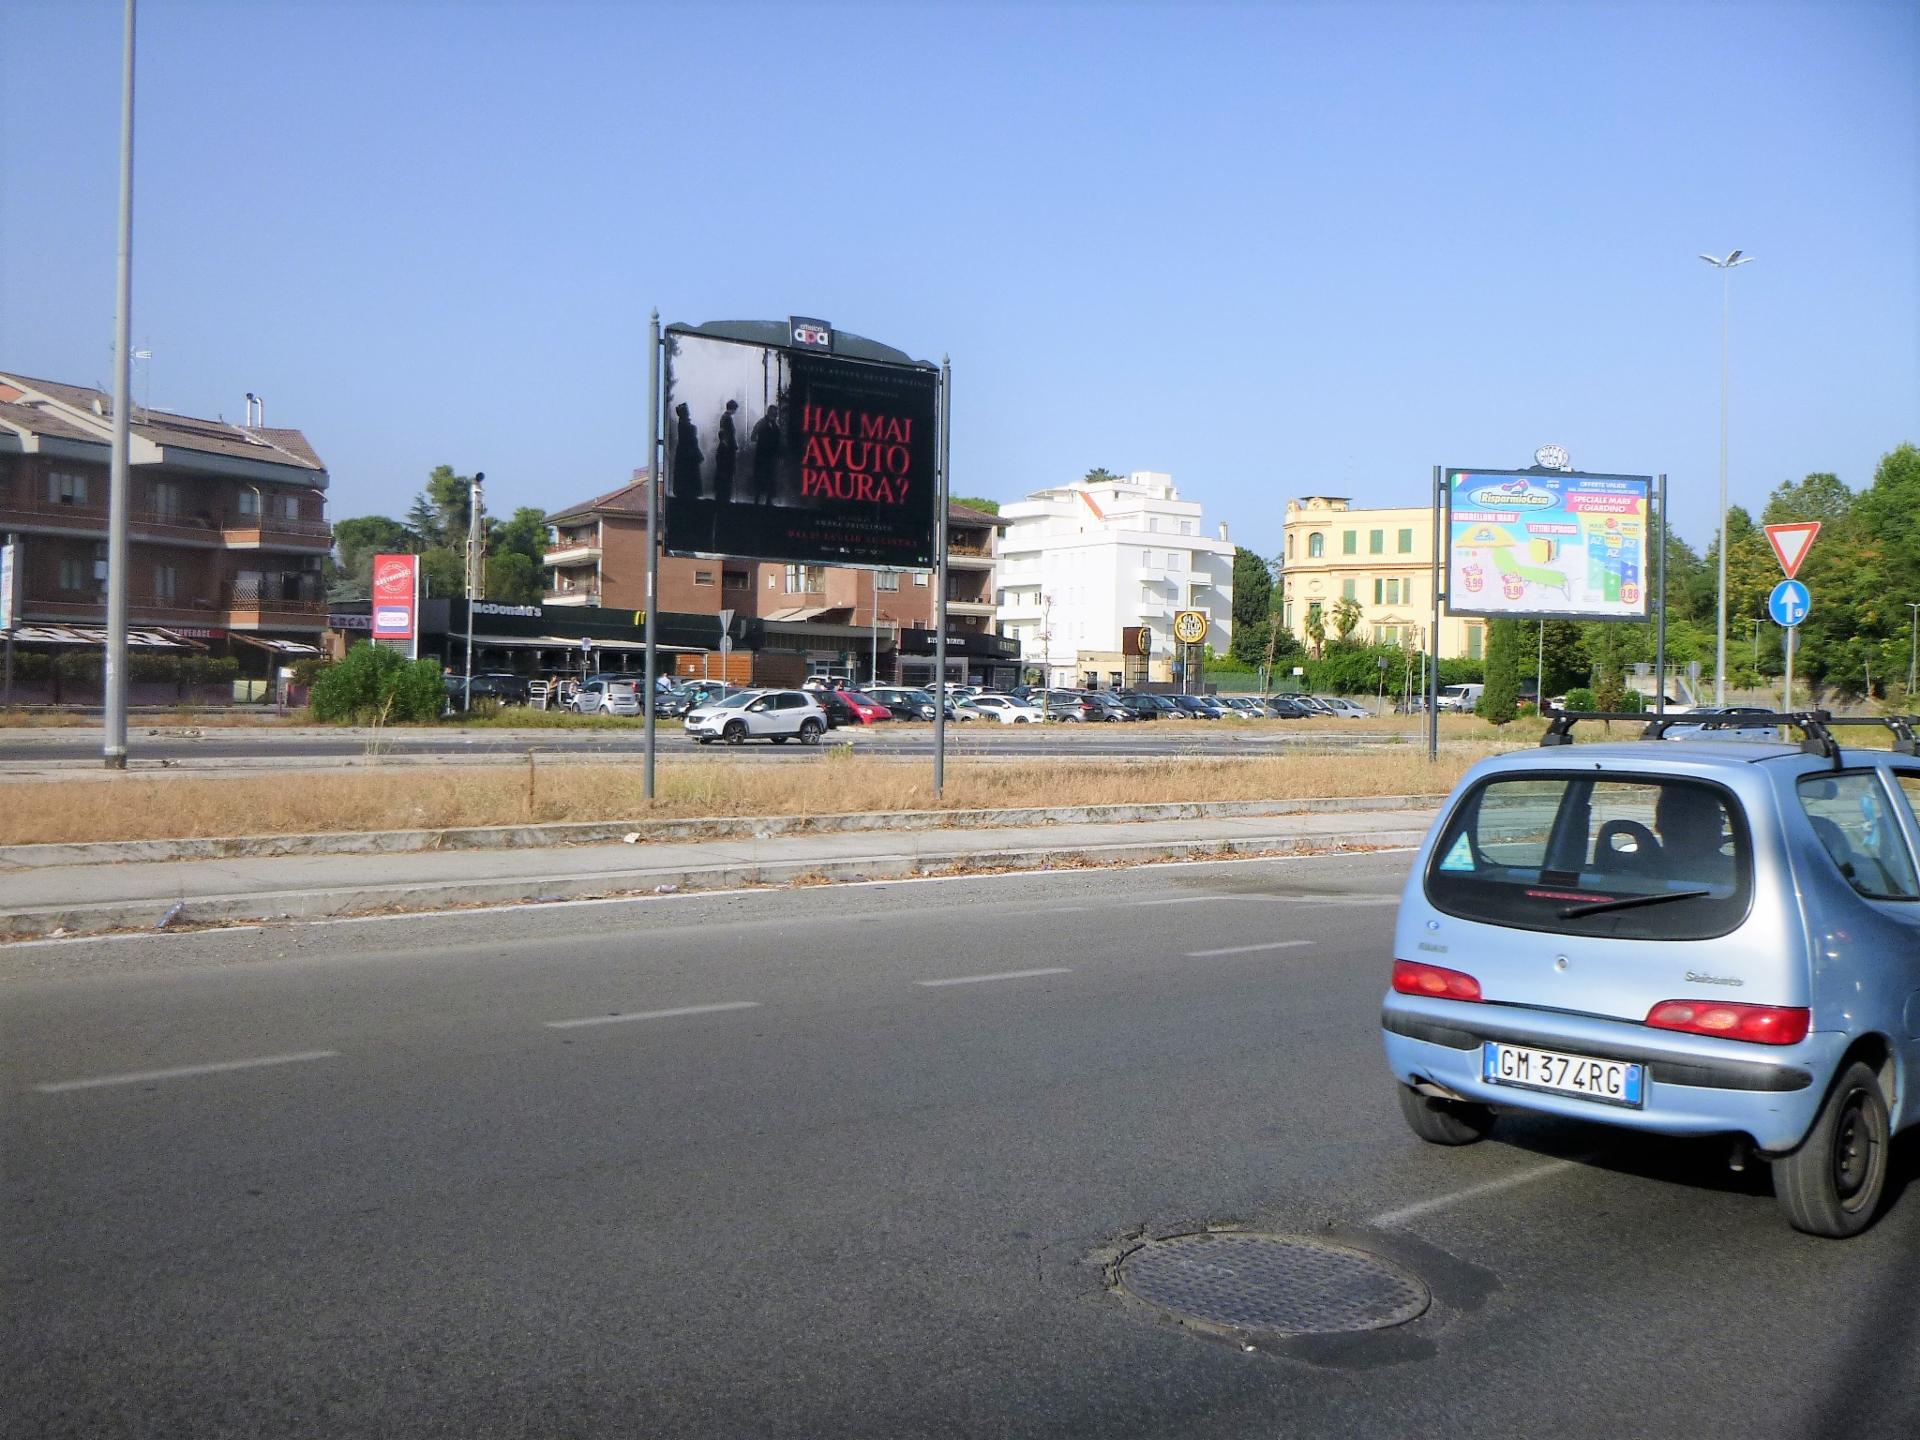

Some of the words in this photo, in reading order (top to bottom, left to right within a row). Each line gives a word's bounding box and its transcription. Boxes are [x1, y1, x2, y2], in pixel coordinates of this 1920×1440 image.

[795, 329, 829, 346] apa
[802, 402, 853, 436] HAI
[860, 410, 912, 444] MAI
[801, 435, 911, 477] AVUTO
[801, 468, 910, 505] PAURA?
[1480, 491, 1549, 505] RisparmioCasa
[1574, 495, 1609, 505] SPECIALE
[1608, 497, 1633, 505] MARE
[1583, 504, 1626, 513] GIARDINO
[472, 602, 542, 617] McDonald's
[1502, 1049, 1529, 1080] GM
[1540, 1055, 1620, 1095] 374RG
